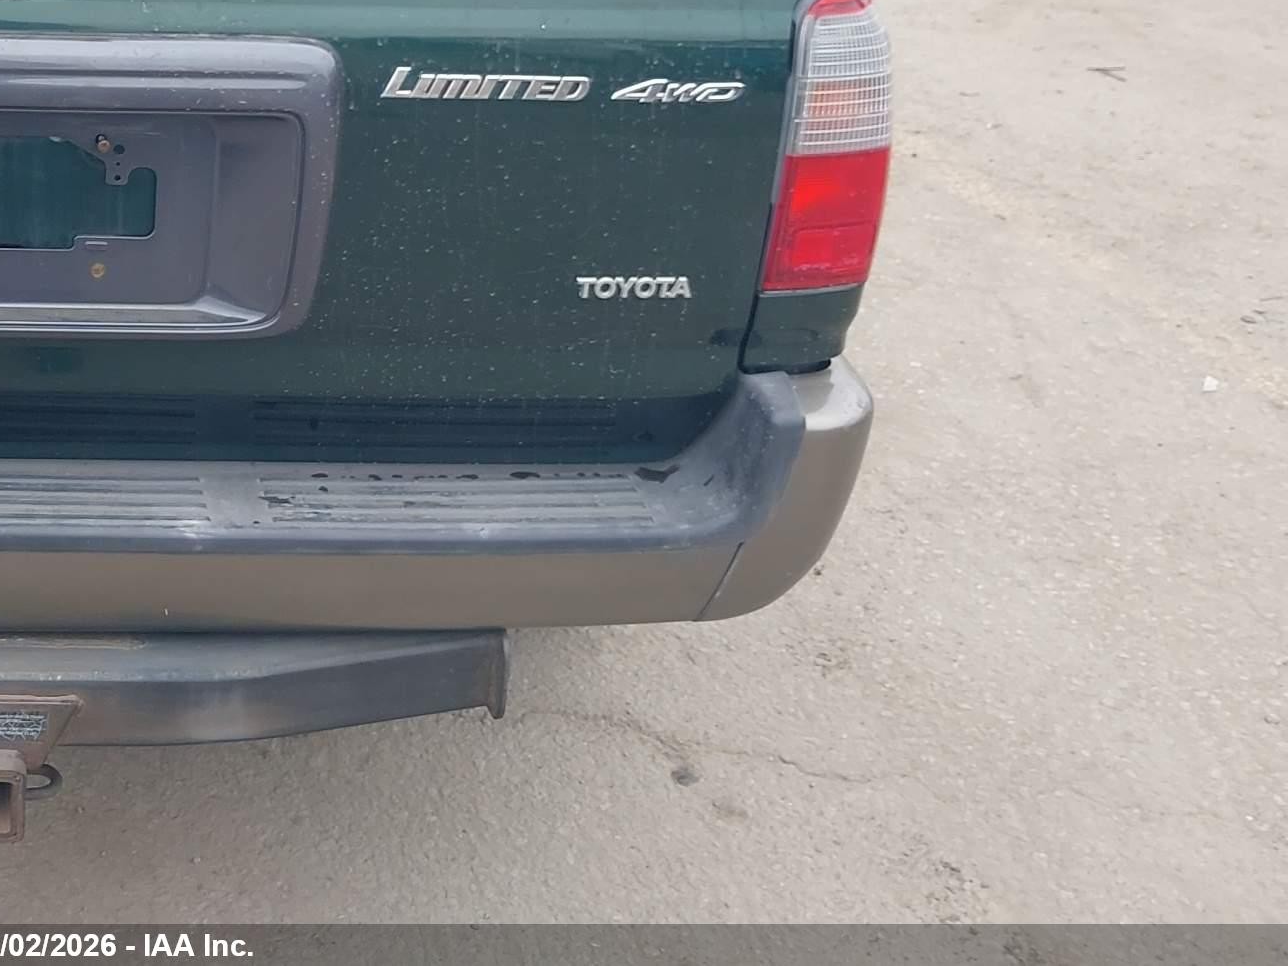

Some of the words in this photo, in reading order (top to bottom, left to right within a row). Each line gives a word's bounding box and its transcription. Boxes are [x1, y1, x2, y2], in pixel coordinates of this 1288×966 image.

[379, 66, 591, 102] LIMITED
[610, 78, 747, 104] 4WD
[576, 276, 693, 299] TOYOTA
